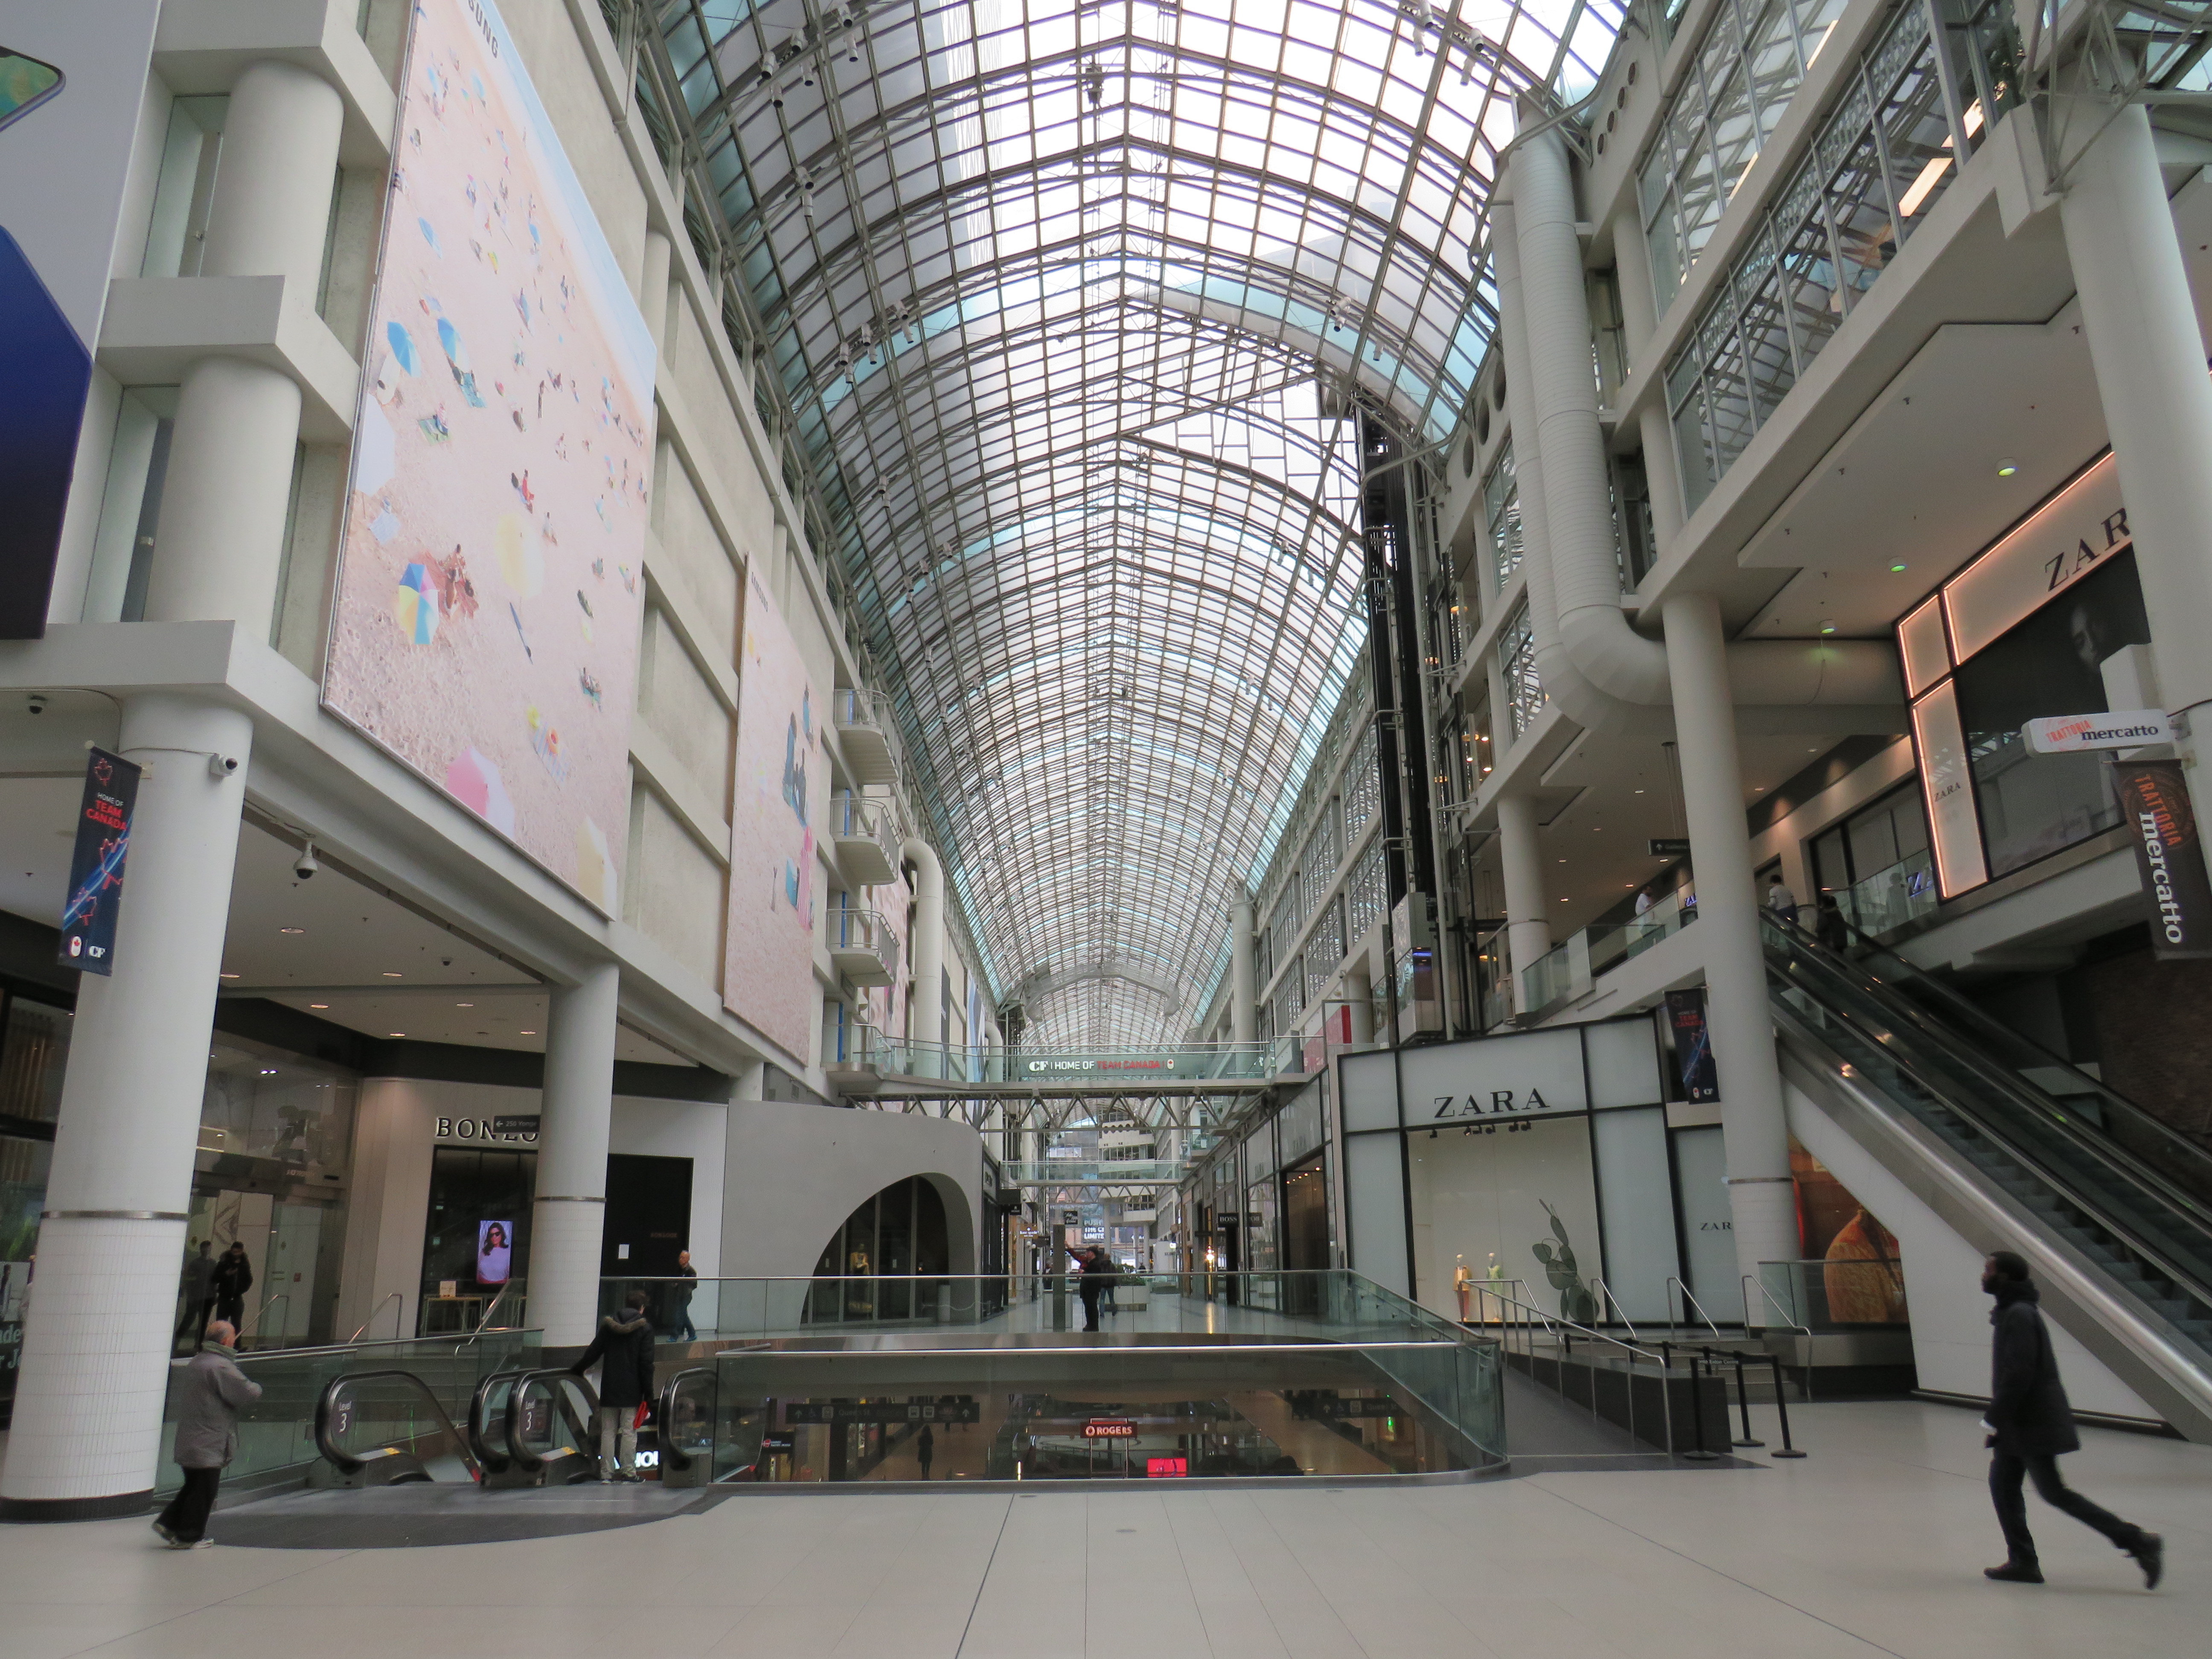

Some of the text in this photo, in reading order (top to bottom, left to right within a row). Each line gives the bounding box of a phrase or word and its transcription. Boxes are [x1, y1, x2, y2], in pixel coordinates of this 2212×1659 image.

[2044, 508, 2130, 591] ZAR
[2046, 720, 2159, 742] TRATTORIA mercatto
[98, 792, 114, 804] HOME
[1935, 782, 1962, 802] ZARA
[86, 808, 127, 830] CANADA
[95, 800, 122, 818] TEAM
[2135, 774, 2183, 847] TRATTORIA
[2139, 812, 2183, 944] mercatto
[1029, 1060, 1161, 1071] CF HOME OF TEAM CANADA
[1434, 1088, 1551, 1118] ZARA
[1700, 1222, 1732, 1231] ZAR
[339, 1400, 352, 1411] Level
[526, 1399, 536, 1410] Level
[339, 1412, 347, 1432] 3
[526, 1411, 532, 1431] 3
[1096, 1426, 1132, 1435] ROGERS
